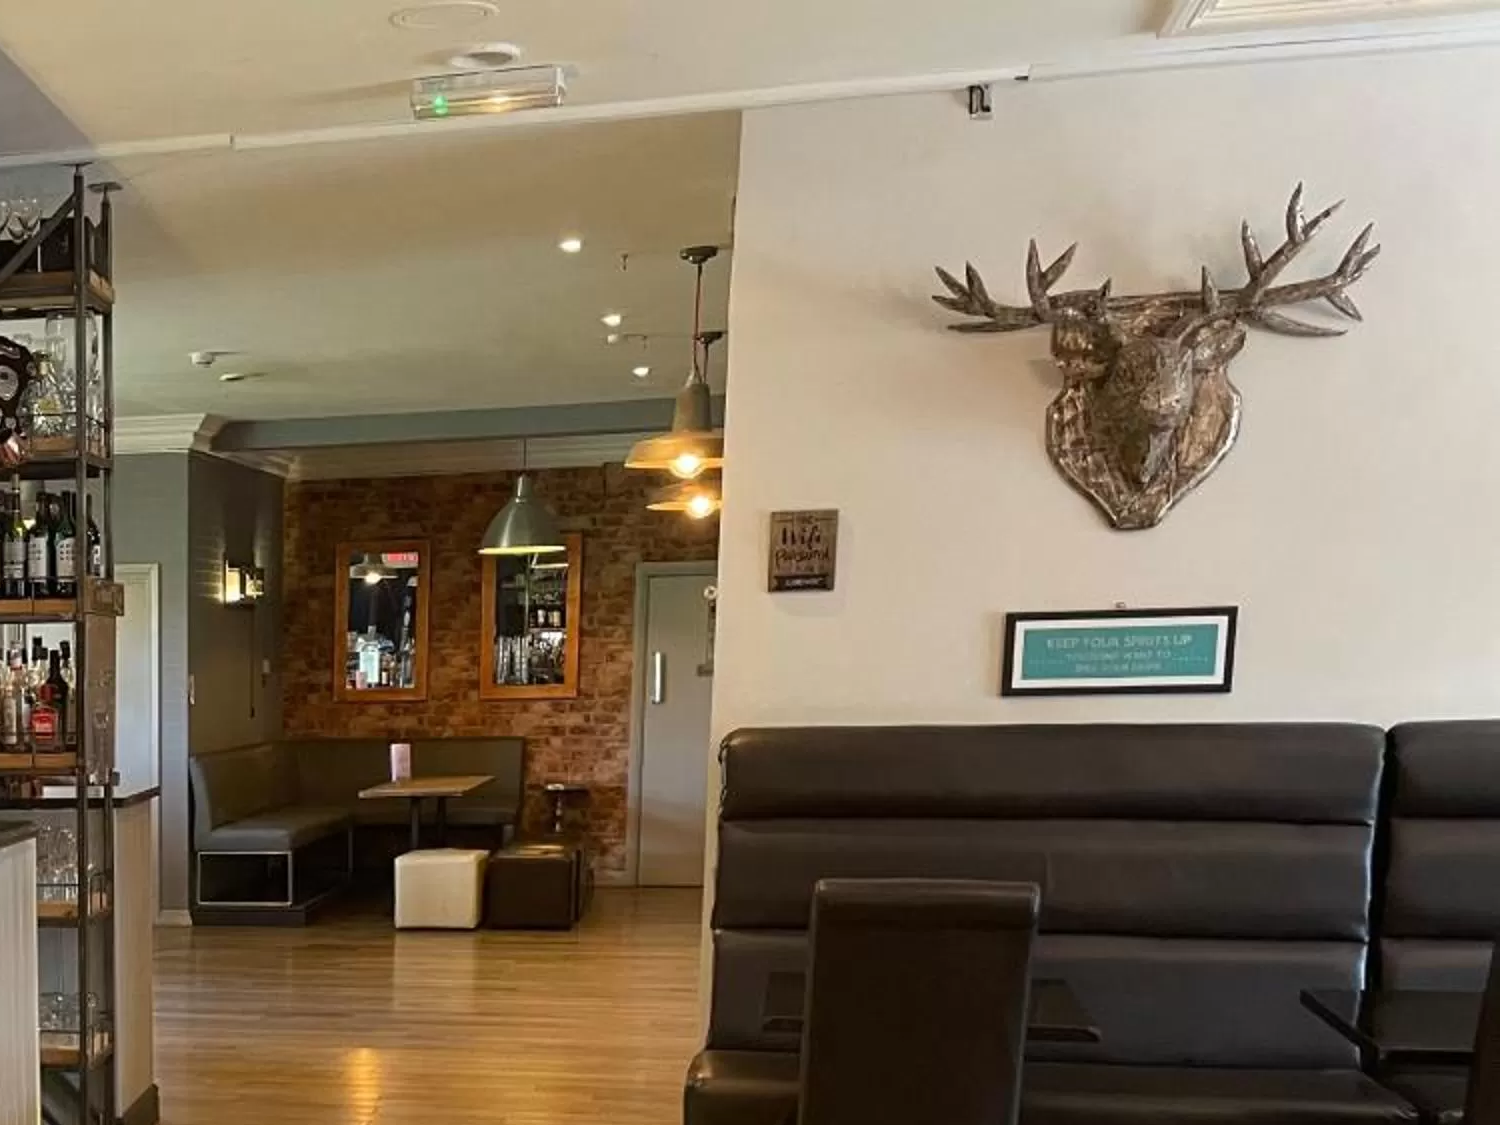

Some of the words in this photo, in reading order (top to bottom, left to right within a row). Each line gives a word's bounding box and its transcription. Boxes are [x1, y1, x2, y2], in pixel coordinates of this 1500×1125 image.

[1047, 637, 1080, 649] KEEP
[1084, 636, 1119, 648] YOUR
[1124, 635, 1171, 648] SPIRITS
[1172, 633, 1193, 646] UP
